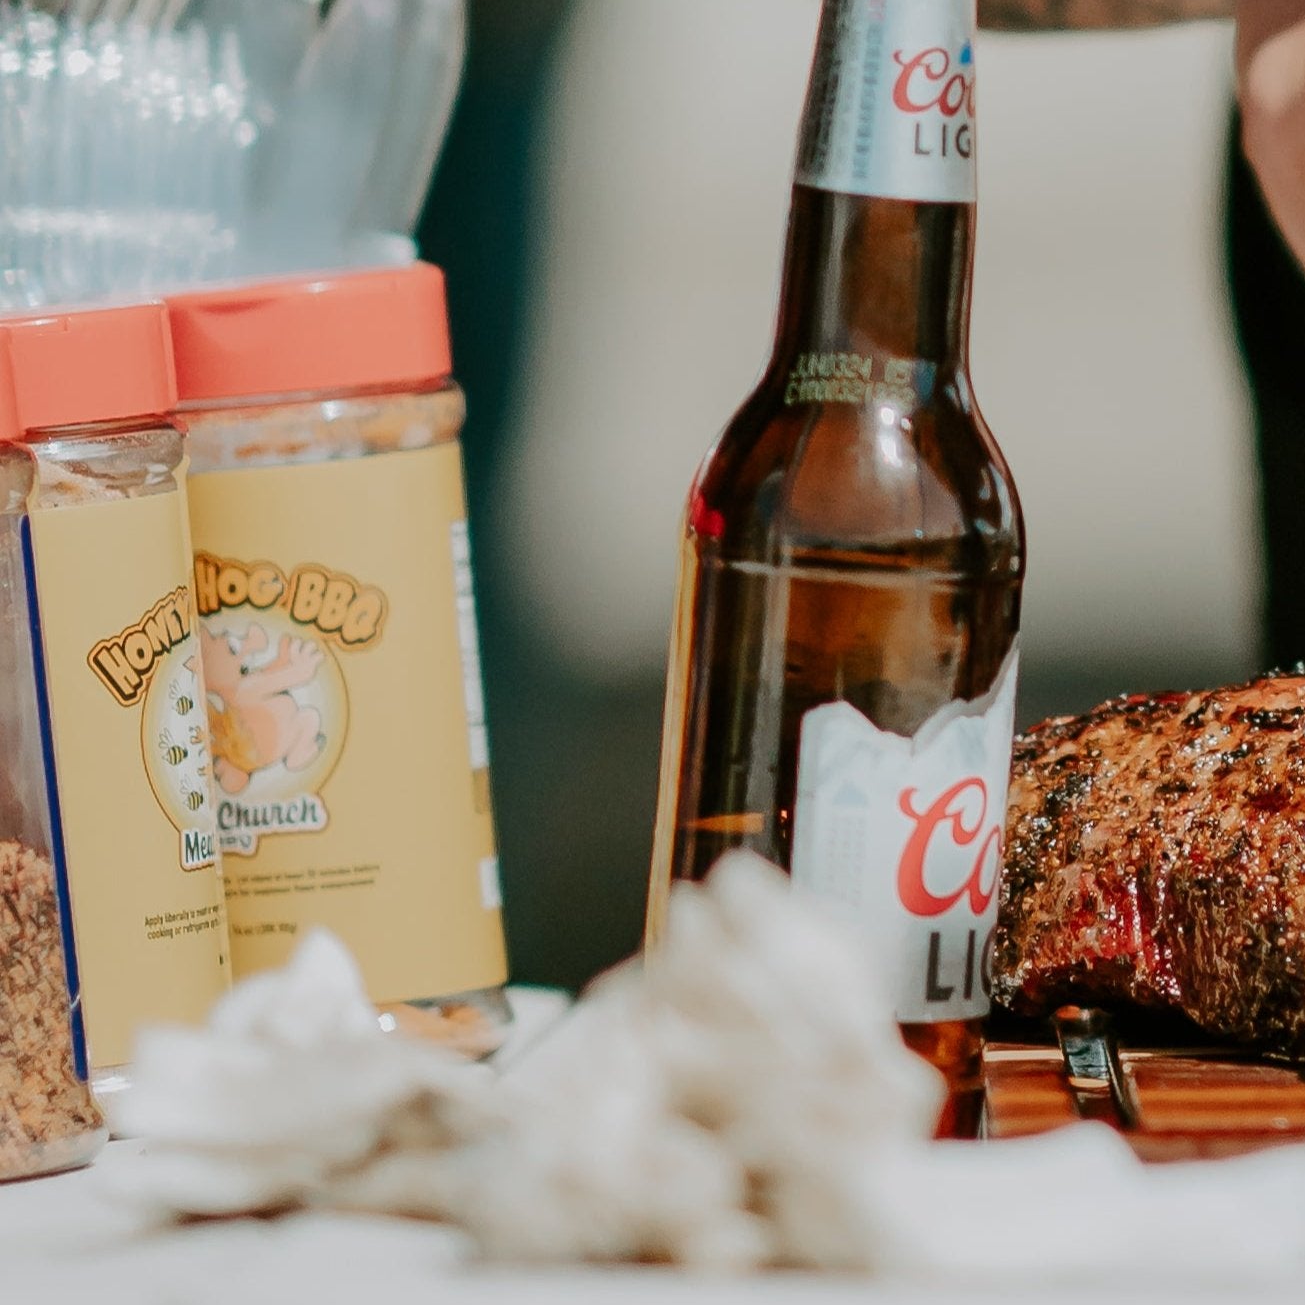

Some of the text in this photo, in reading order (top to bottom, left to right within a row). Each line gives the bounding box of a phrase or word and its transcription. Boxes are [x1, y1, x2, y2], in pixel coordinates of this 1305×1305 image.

[194, 554, 284, 616] HOG
[291, 567, 382, 645] BBQ
[217, 799, 319, 830] Church
